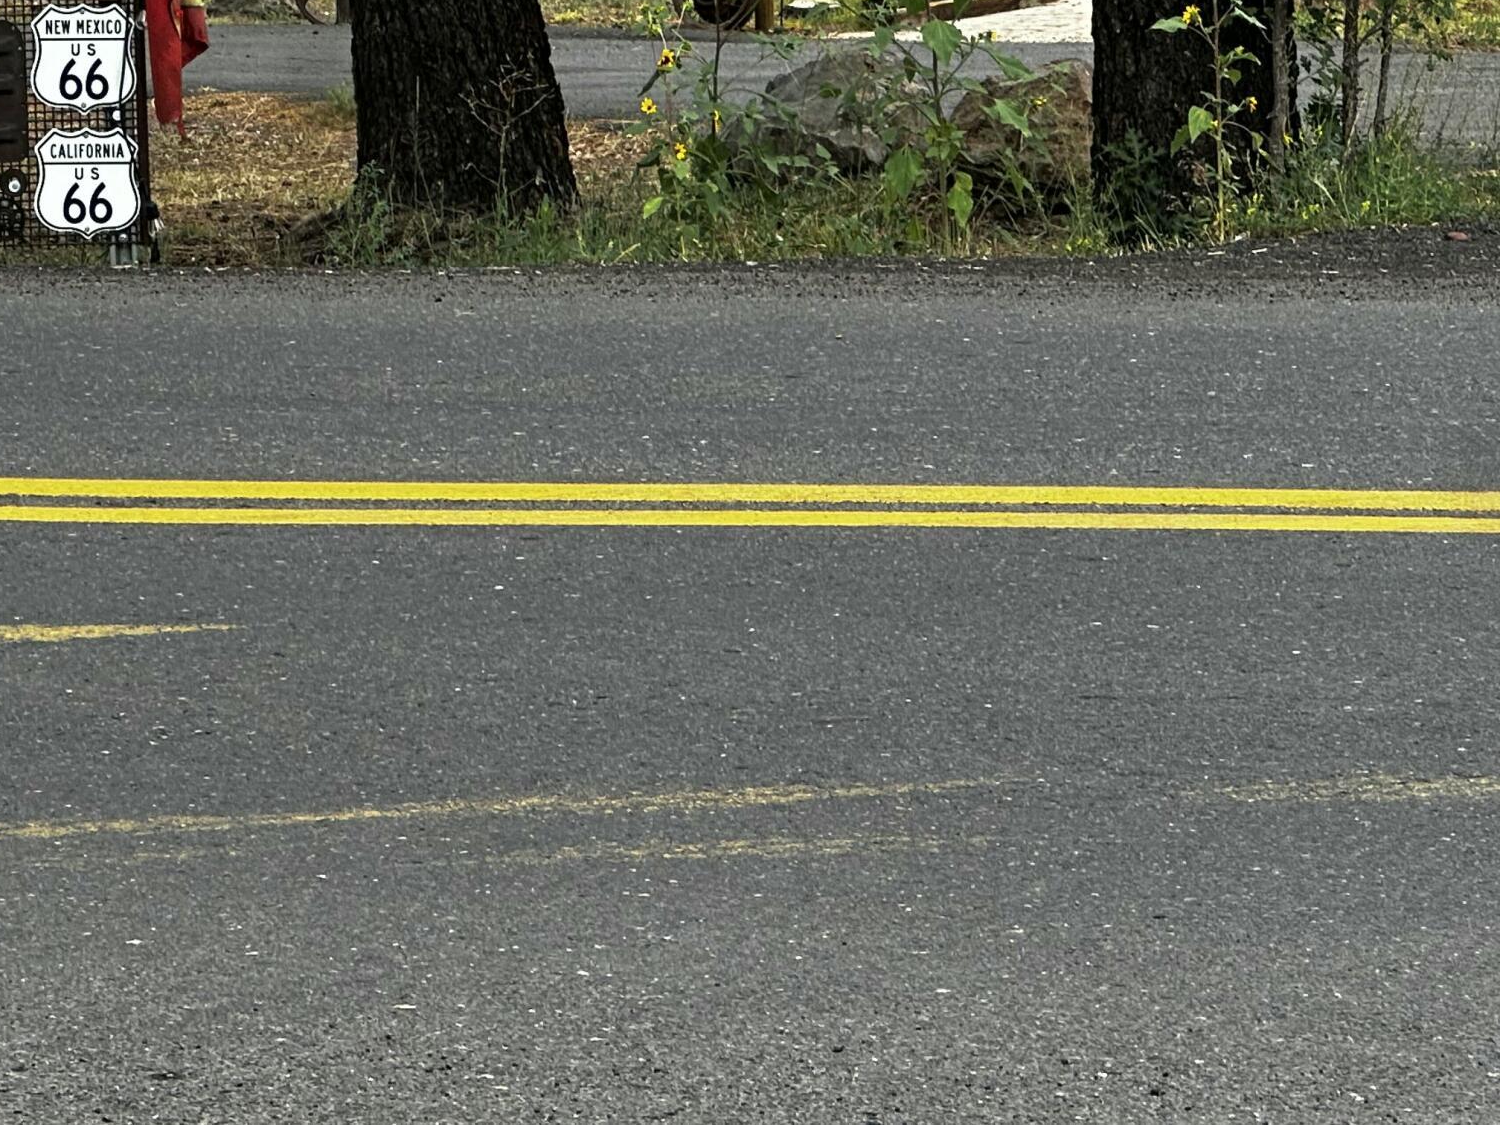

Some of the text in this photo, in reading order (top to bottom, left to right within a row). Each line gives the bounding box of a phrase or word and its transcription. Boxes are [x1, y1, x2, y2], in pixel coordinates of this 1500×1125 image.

[45, 19, 122, 35] NEW MEXICO
[59, 58, 109, 101] 66
[50, 143, 125, 159] CALIFORNIA
[63, 181, 113, 225] 66
